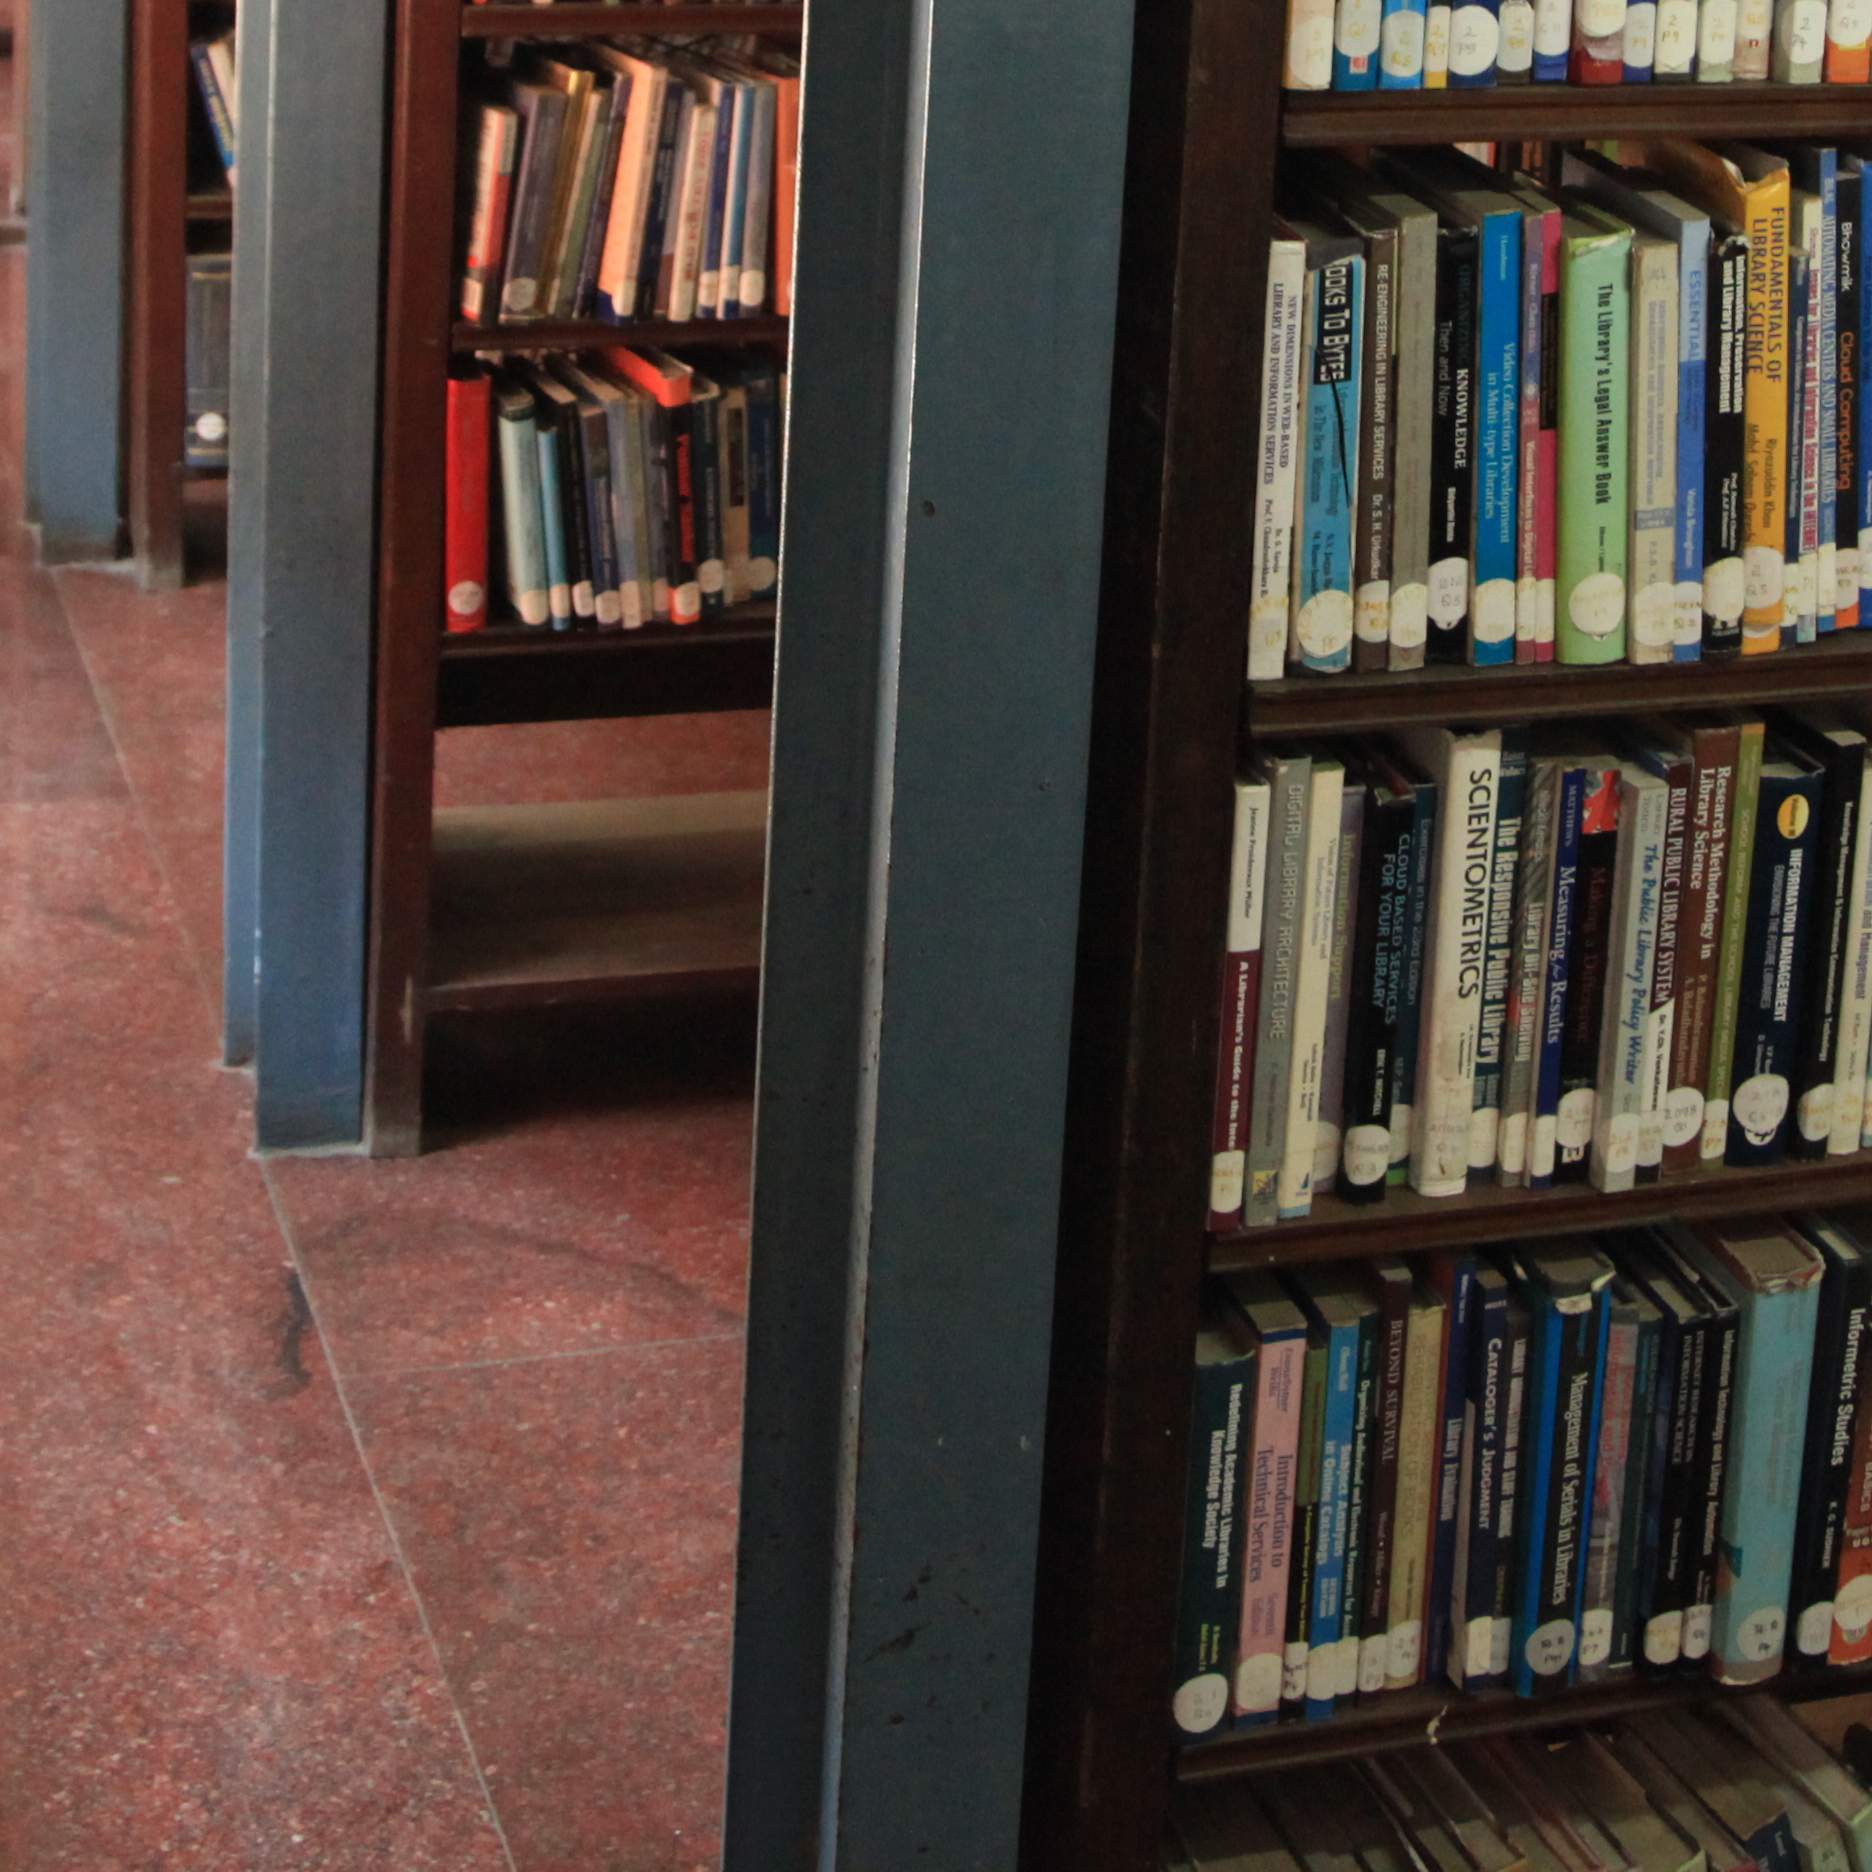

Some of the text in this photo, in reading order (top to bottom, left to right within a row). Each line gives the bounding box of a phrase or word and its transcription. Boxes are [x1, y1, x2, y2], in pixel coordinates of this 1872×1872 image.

[1747, 218, 1766, 376] LIBRARY SCIENCE
[1766, 206, 1787, 385] FUNDAMENTALS OF
[1839, 221, 1854, 292] Bhowmik
[1452, 367, 1470, 470] KNOWLEDGE
[1594, 282, 1614, 506] The Library's Legal Answer Book
[1834, 331, 1855, 491] Cloud Computing
[1456, 767, 1493, 1002] SCIENTOMETRICS
[1479, 816, 1522, 1064] The Responsive Public Library
[1545, 865, 1575, 1045] Measuring for Results
[1653, 786, 1688, 1004] RURAL PUBLIC LIBRARY SYSTEM
[1774, 848, 1803, 1023] INFORMATION MANAGEMENT
[1382, 1319, 1404, 1465] BEYOND SURVIVAL
[1477, 1337, 1502, 1530] CATALOGER'S JUDGMENT
[1830, 1307, 1867, 1468] Informetric Studies
